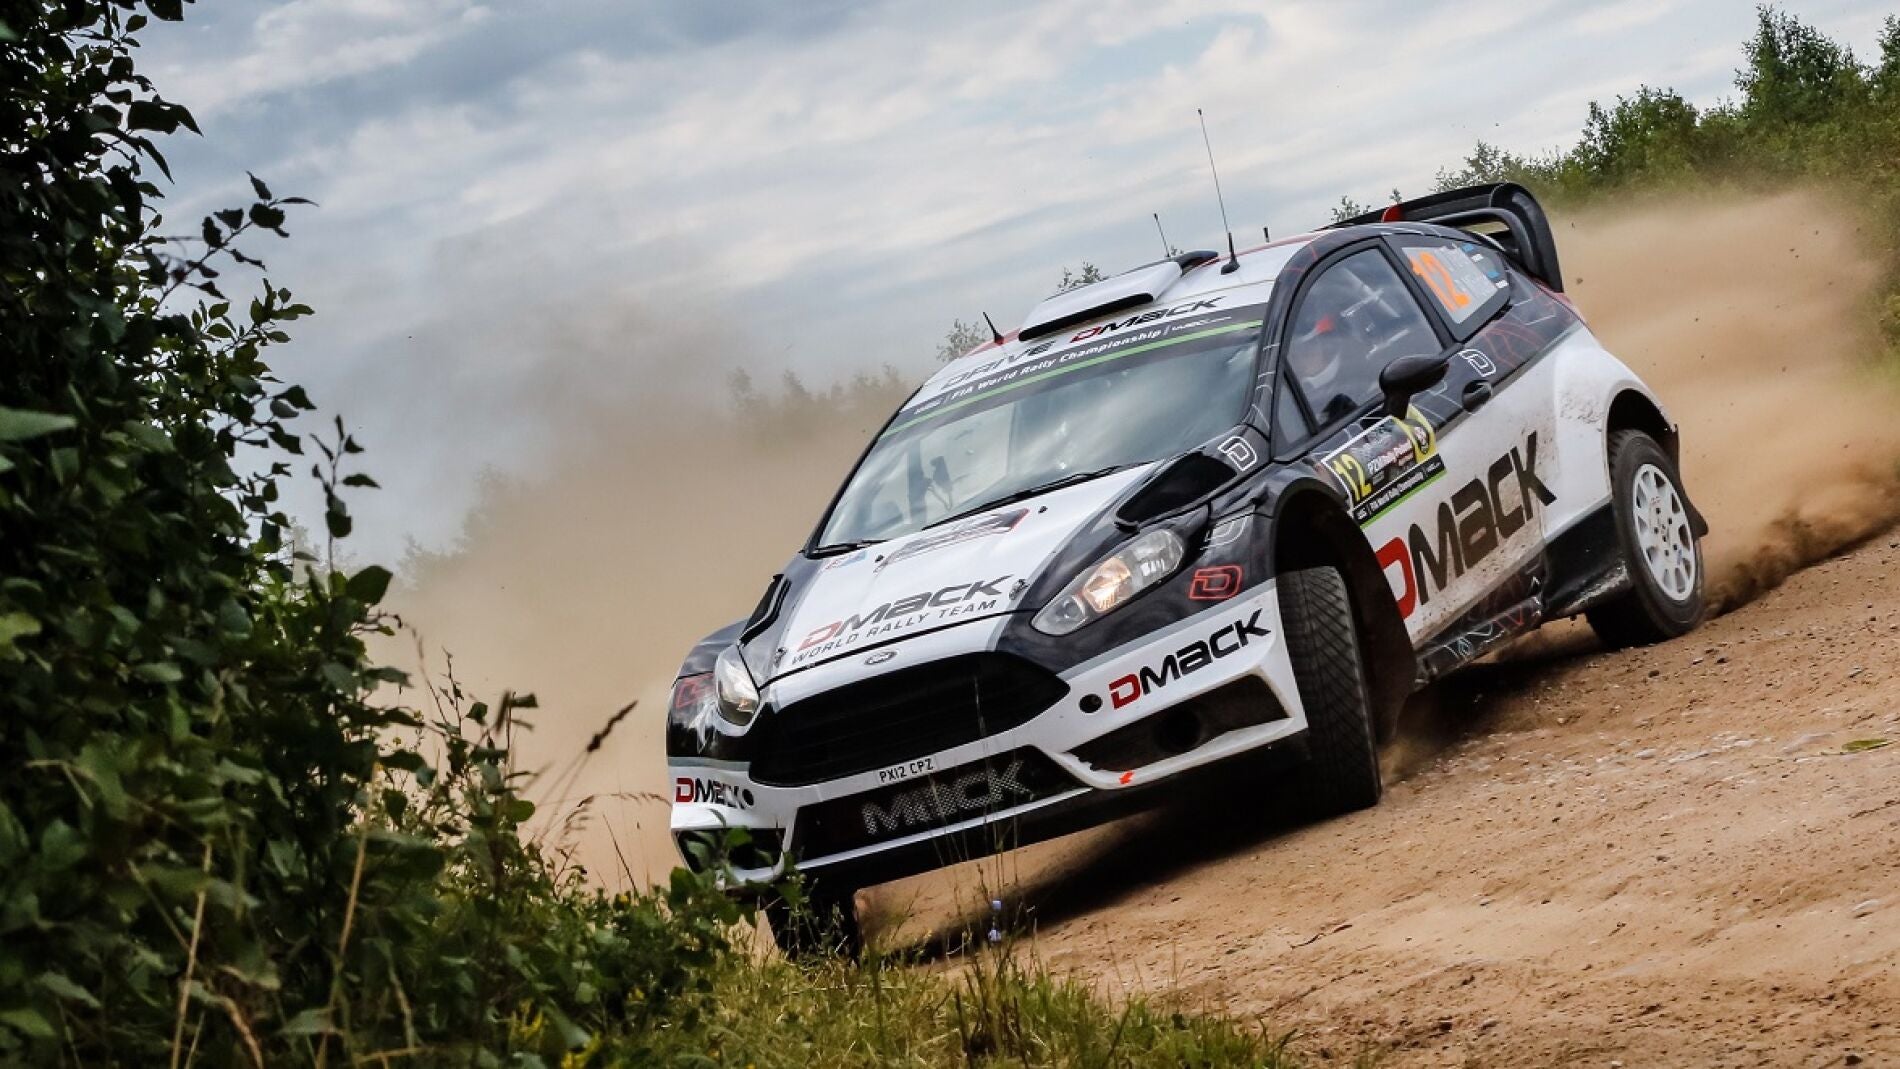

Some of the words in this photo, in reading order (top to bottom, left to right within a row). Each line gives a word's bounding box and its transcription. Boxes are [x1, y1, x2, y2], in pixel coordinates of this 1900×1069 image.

[1408, 251, 1471, 312] 12
[978, 369, 1018, 390] World
[1020, 358, 1057, 377] Rally
[1060, 328, 1162, 363] Championship
[1332, 453, 1372, 502] 12
[792, 632, 859, 665] WORLD
[867, 611, 930, 638] RALLY
[938, 599, 997, 618] TEAM
[878, 766, 907, 784] PX12
[909, 758, 935, 775] CPZ
